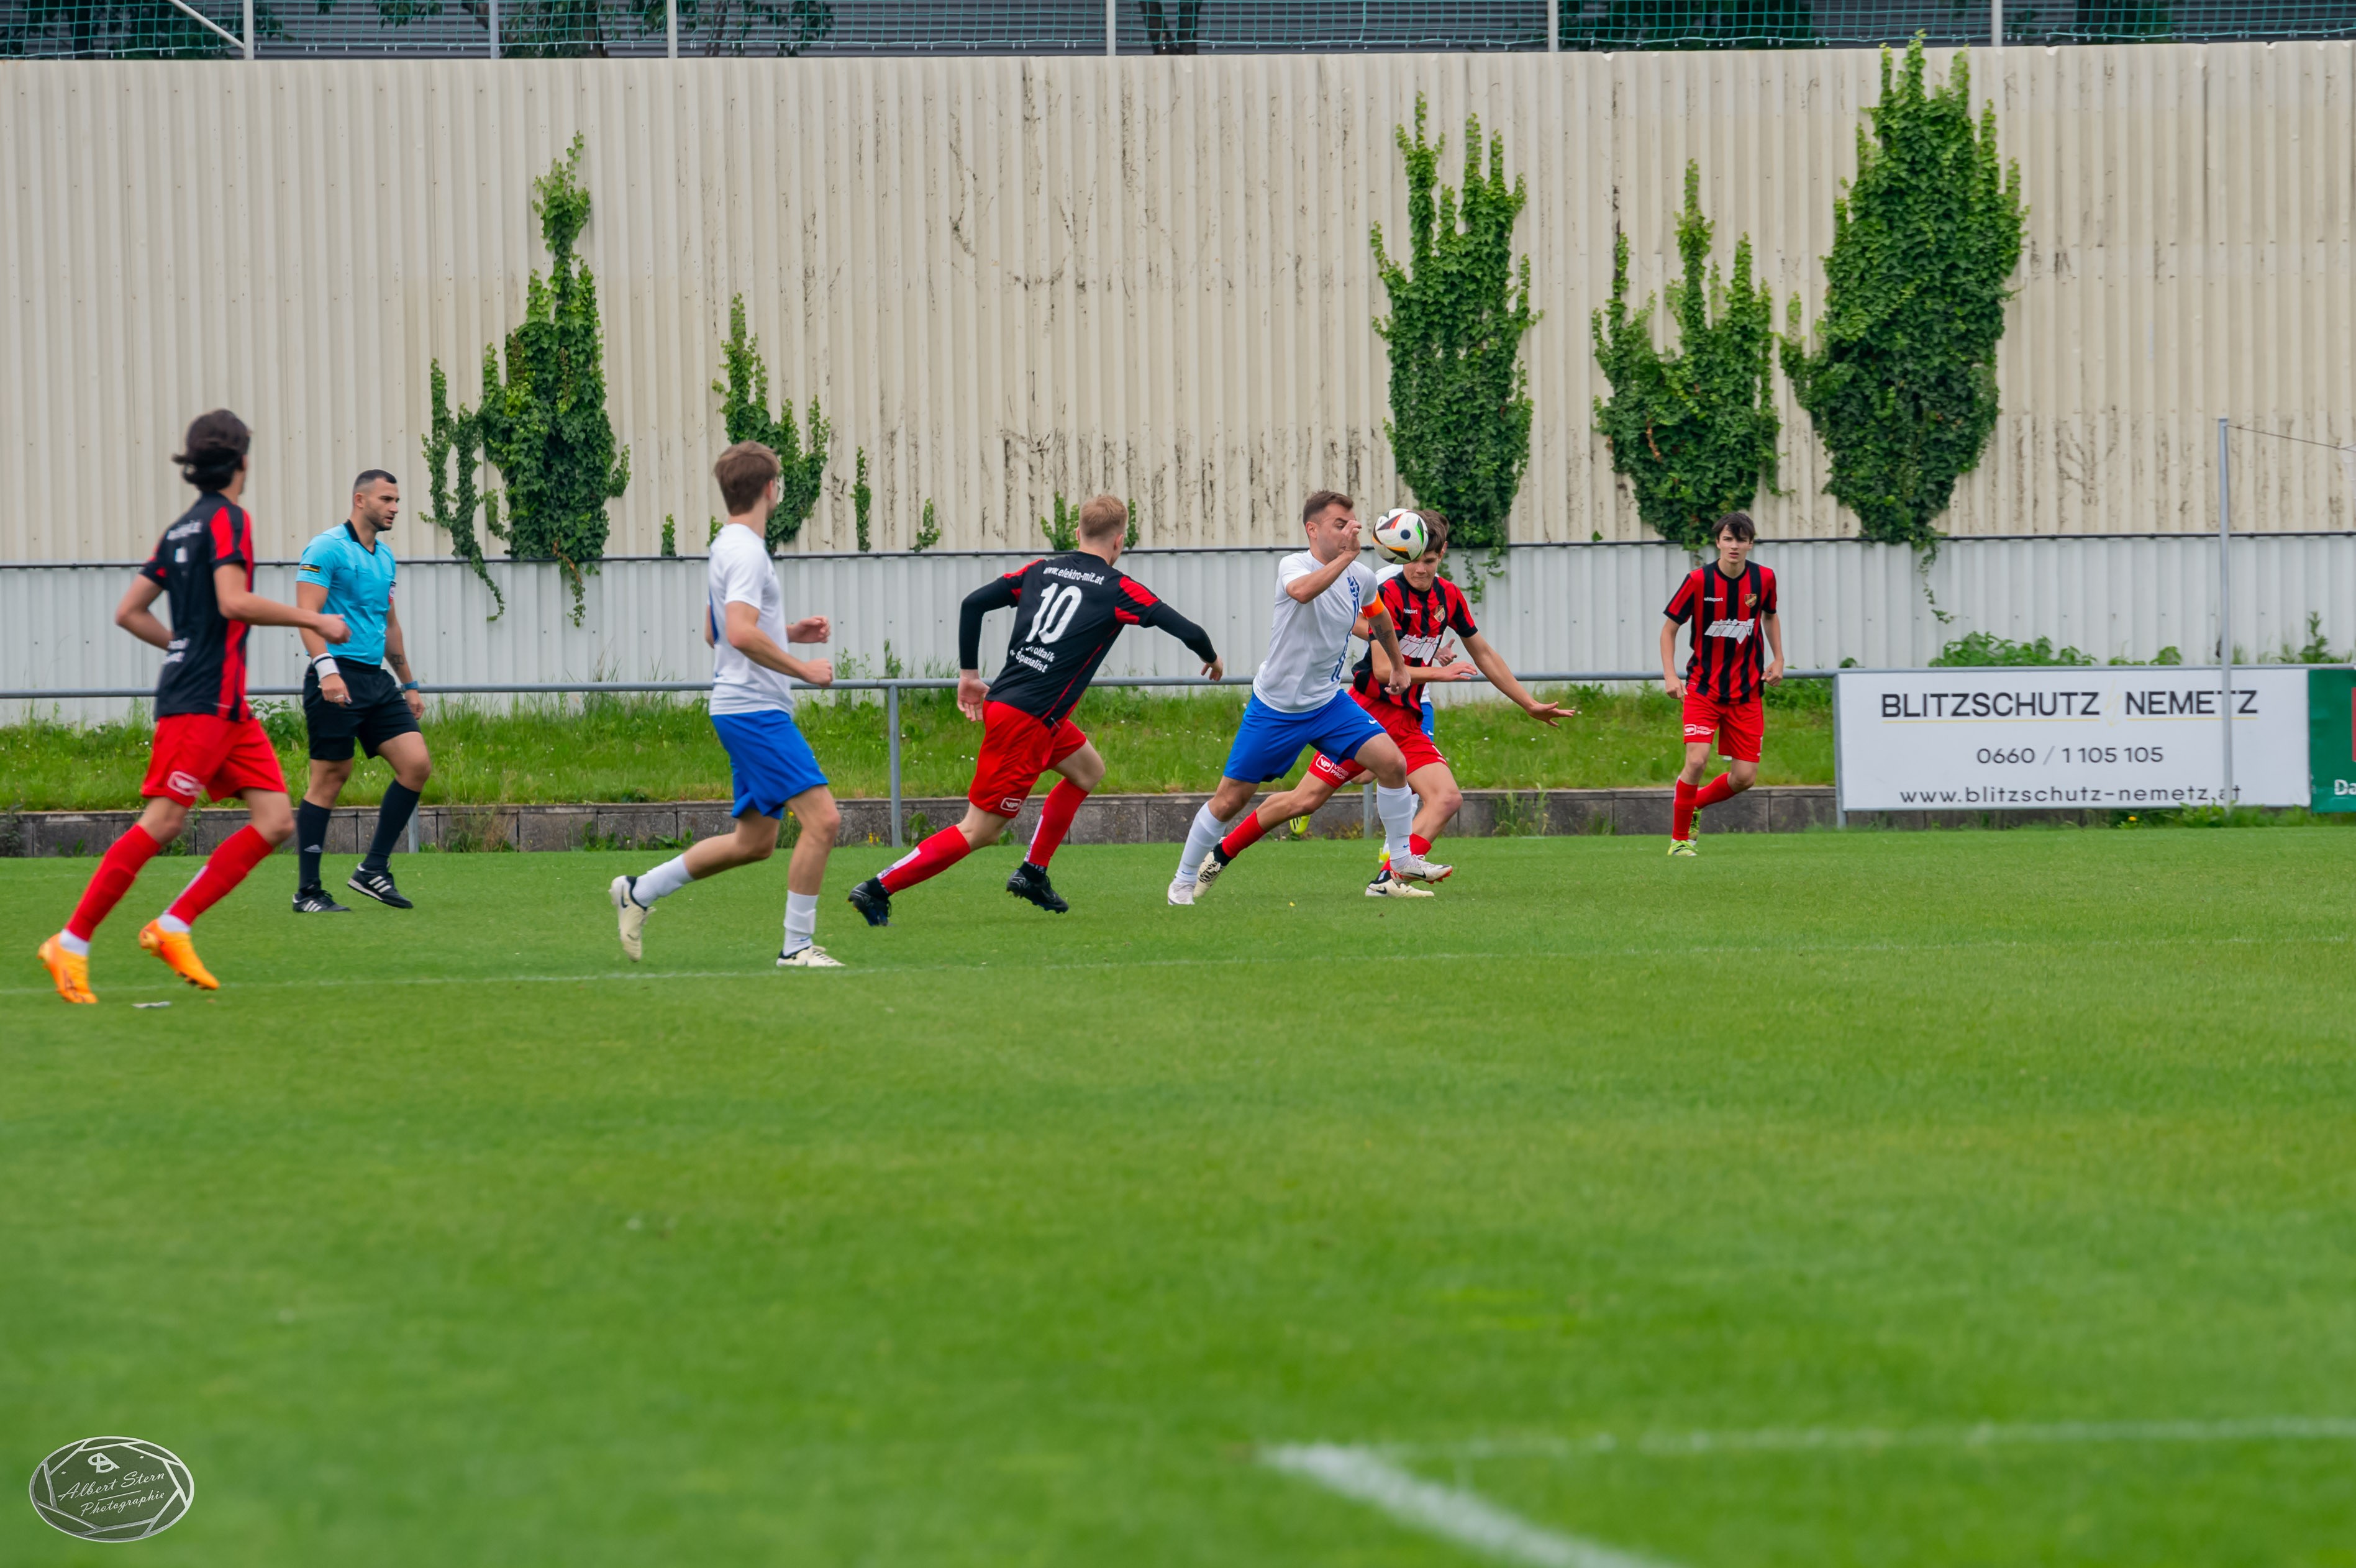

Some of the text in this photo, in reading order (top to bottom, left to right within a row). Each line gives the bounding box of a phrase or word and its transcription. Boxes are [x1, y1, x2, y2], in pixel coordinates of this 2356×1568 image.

[1043, 566, 1104, 585] www.elektro-mit.at
[1025, 582, 1083, 645] 10
[1881, 690, 2258, 717] BLITZSCHUTZ NEMEZ
[1976, 748, 2035, 764] 0660
